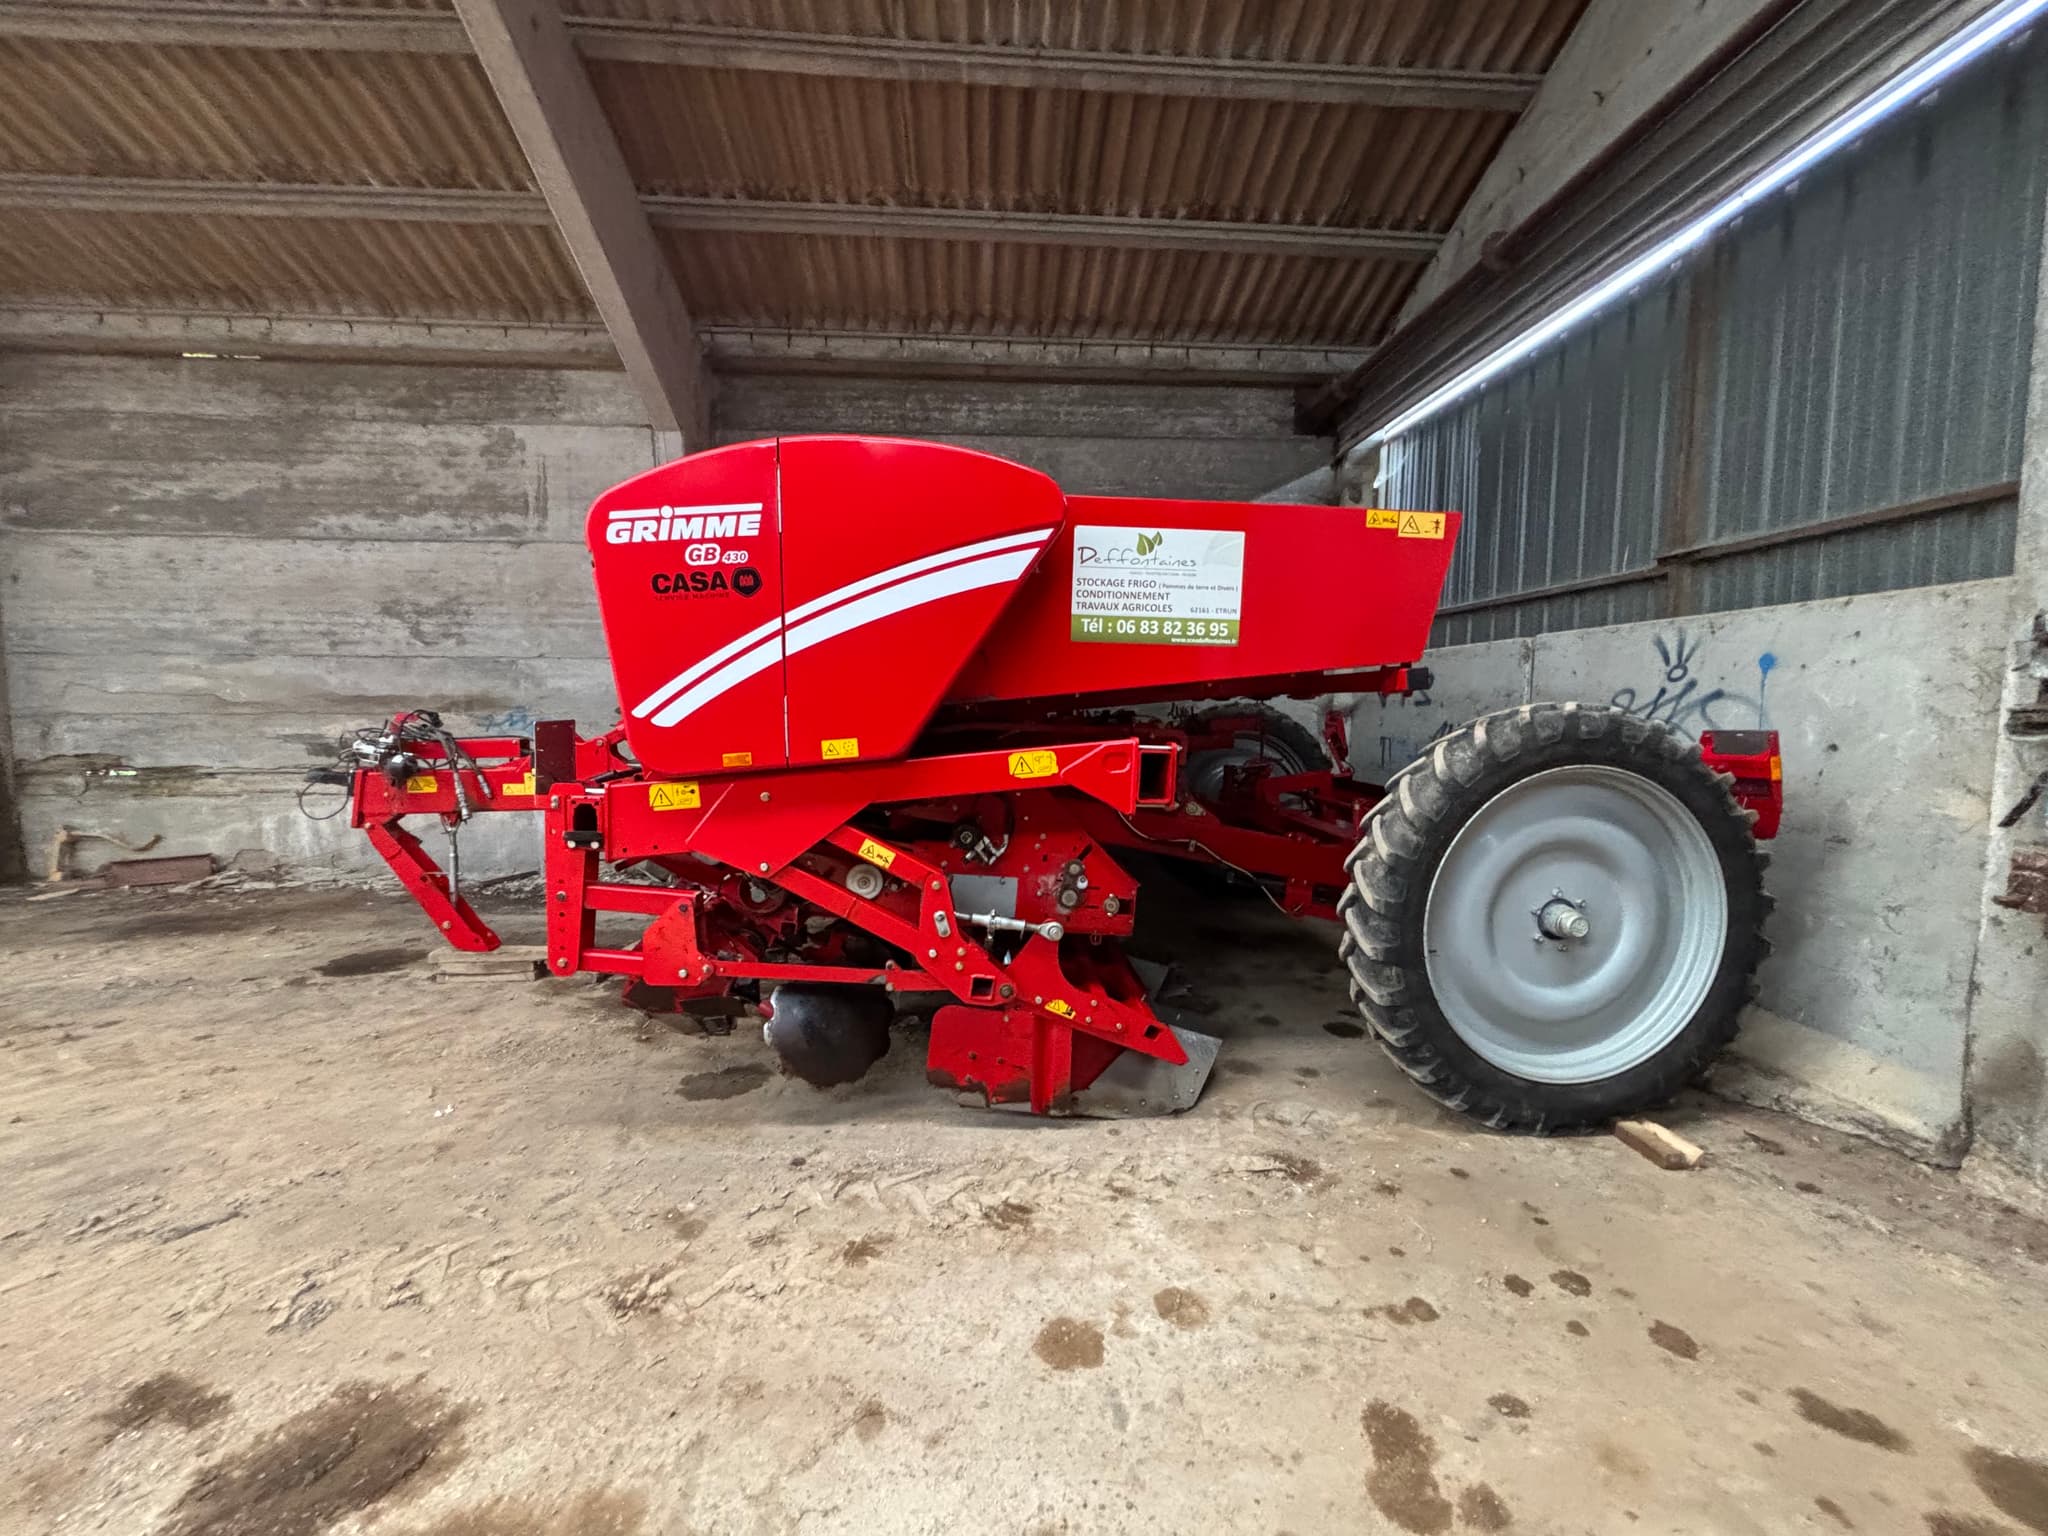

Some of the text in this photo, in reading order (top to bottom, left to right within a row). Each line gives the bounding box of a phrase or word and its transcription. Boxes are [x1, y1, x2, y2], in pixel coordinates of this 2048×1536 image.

[606, 504, 763, 544] GRIMME
[686, 545, 748, 564] GB 430
[1078, 546, 1197, 567] Deffontaines
[652, 571, 728, 594] CASA
[1076, 577, 1125, 588] STOCKAGE
[1128, 579, 1157, 588] FRIGO
[1076, 589, 1170, 601] CONDITIONNEMENT
[1076, 601, 1173, 613] TRAVAUX AGRICOLES
[1081, 617, 1103, 633] Tél
[1116, 619, 1136, 634] 06
[1140, 620, 1159, 635] 83
[1163, 620, 1182, 636] 82
[1186, 621, 1206, 636] 36
[1209, 622, 1229, 637] 95
